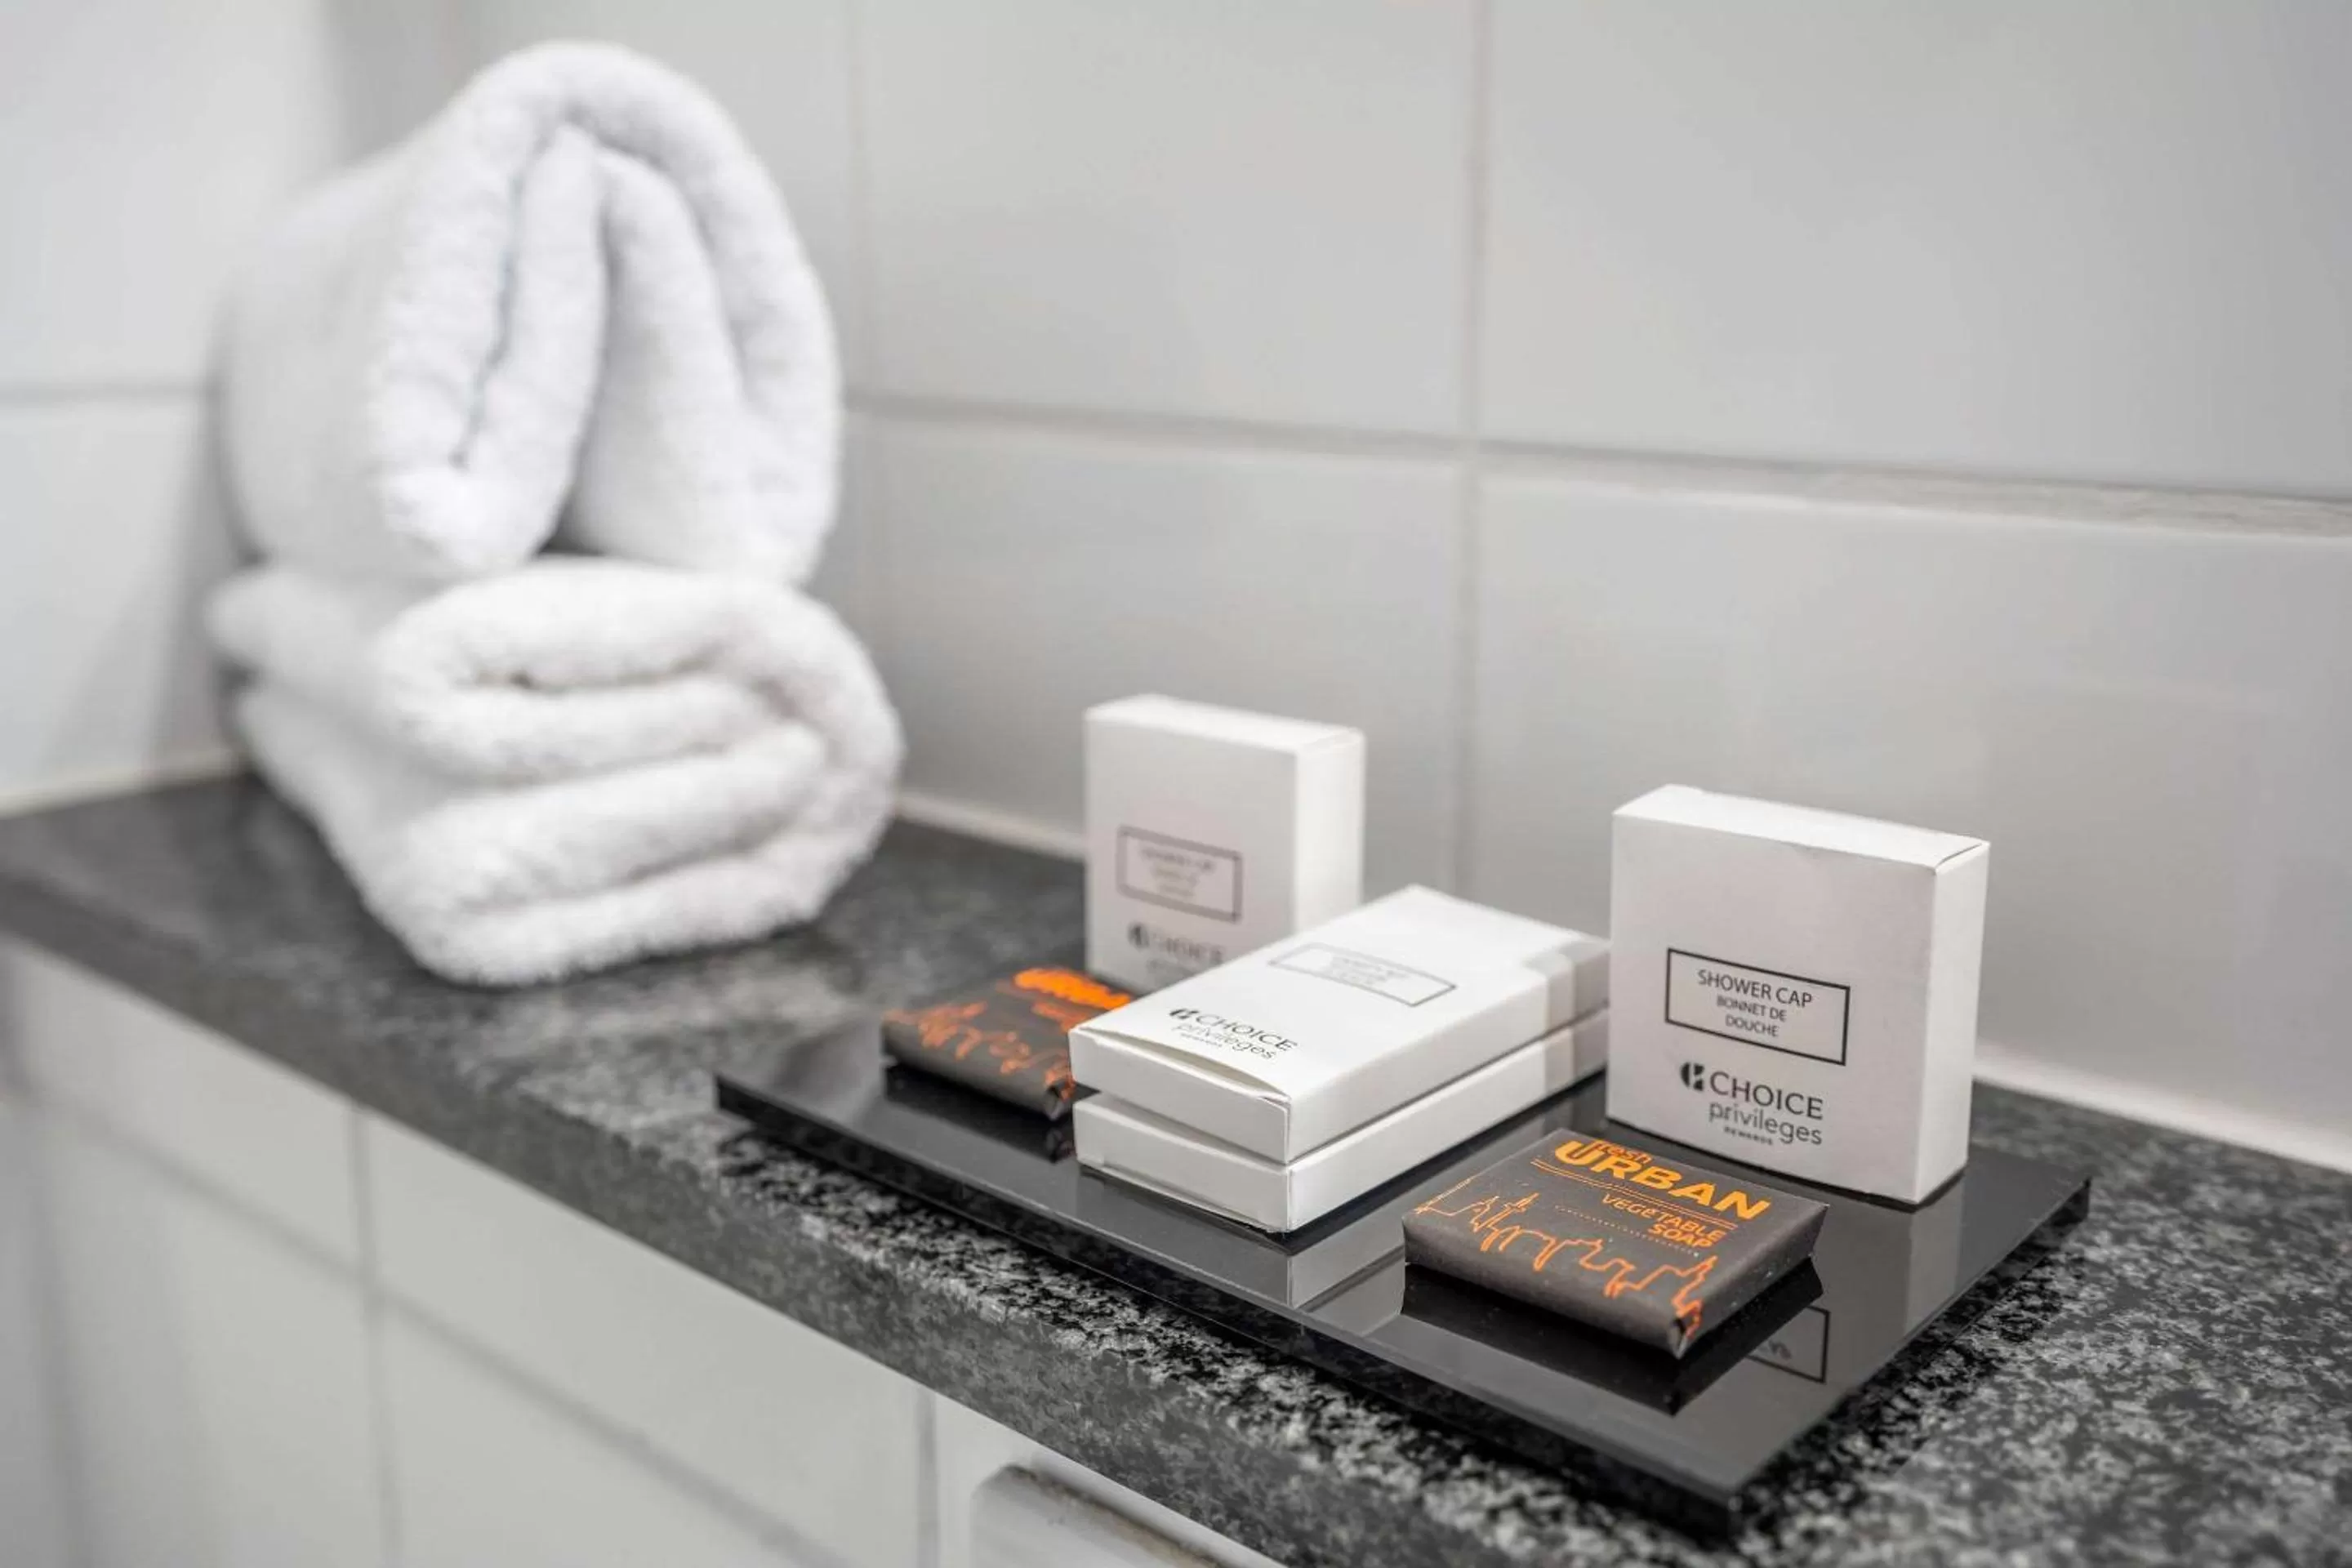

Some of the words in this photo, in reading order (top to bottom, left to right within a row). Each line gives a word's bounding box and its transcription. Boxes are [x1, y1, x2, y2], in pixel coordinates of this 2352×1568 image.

[1697, 969, 1772, 1000] SHOWER
[1775, 987, 1812, 1009] CAP
[1717, 996, 1766, 1017] BONNET
[1769, 1005, 1787, 1022] DE
[1725, 1015, 1779, 1037] DOUCHE
[1171, 1023, 1276, 1059] privileges
[1196, 1014, 1298, 1052] CHOICE
[1709, 1071, 1824, 1120] CHOICE
[1708, 1102, 1822, 1145] privileges
[1592, 1139, 1651, 1165] fresh
[1555, 1140, 1771, 1219] URBAN
[1601, 1193, 1727, 1241] VEGETABLE
[1647, 1223, 1713, 1248] SOAP
